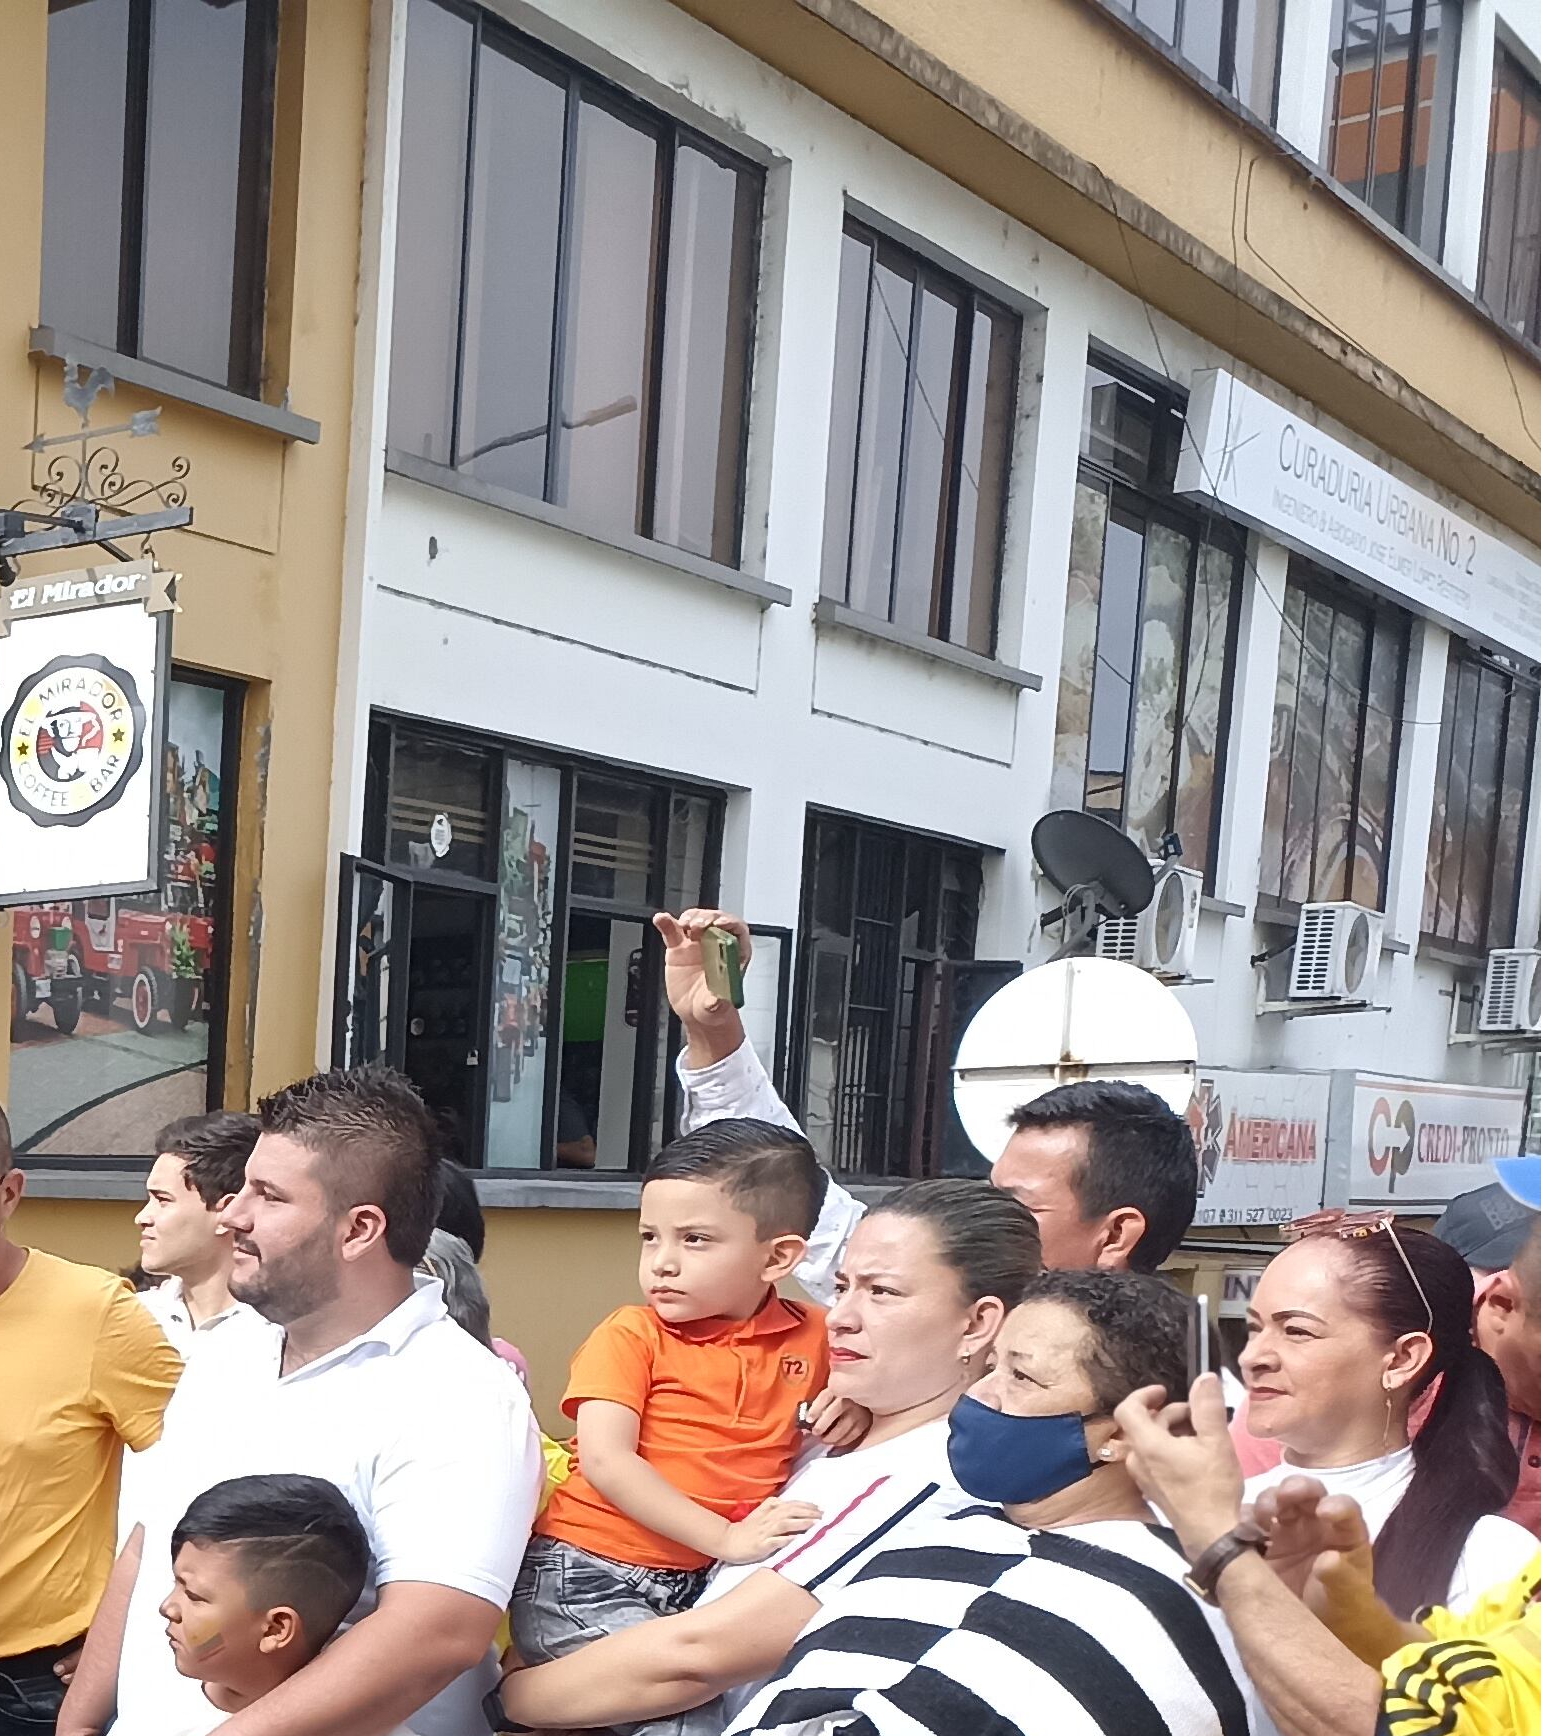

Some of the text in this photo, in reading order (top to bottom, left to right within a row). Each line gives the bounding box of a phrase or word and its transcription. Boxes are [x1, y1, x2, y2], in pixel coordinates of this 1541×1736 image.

[1279, 424, 1372, 518] CURADURIA
[1377, 480, 1434, 552] URBANA
[1465, 534, 1477, 577] 2
[9, 573, 142, 610] El Mirador
[38, 677, 124, 721] MIRADOR
[18, 754, 120, 807] COFFEE BAR
[1223, 1109, 1317, 1163] AMERICANA
[1245, 1207, 1265, 1223] 527
